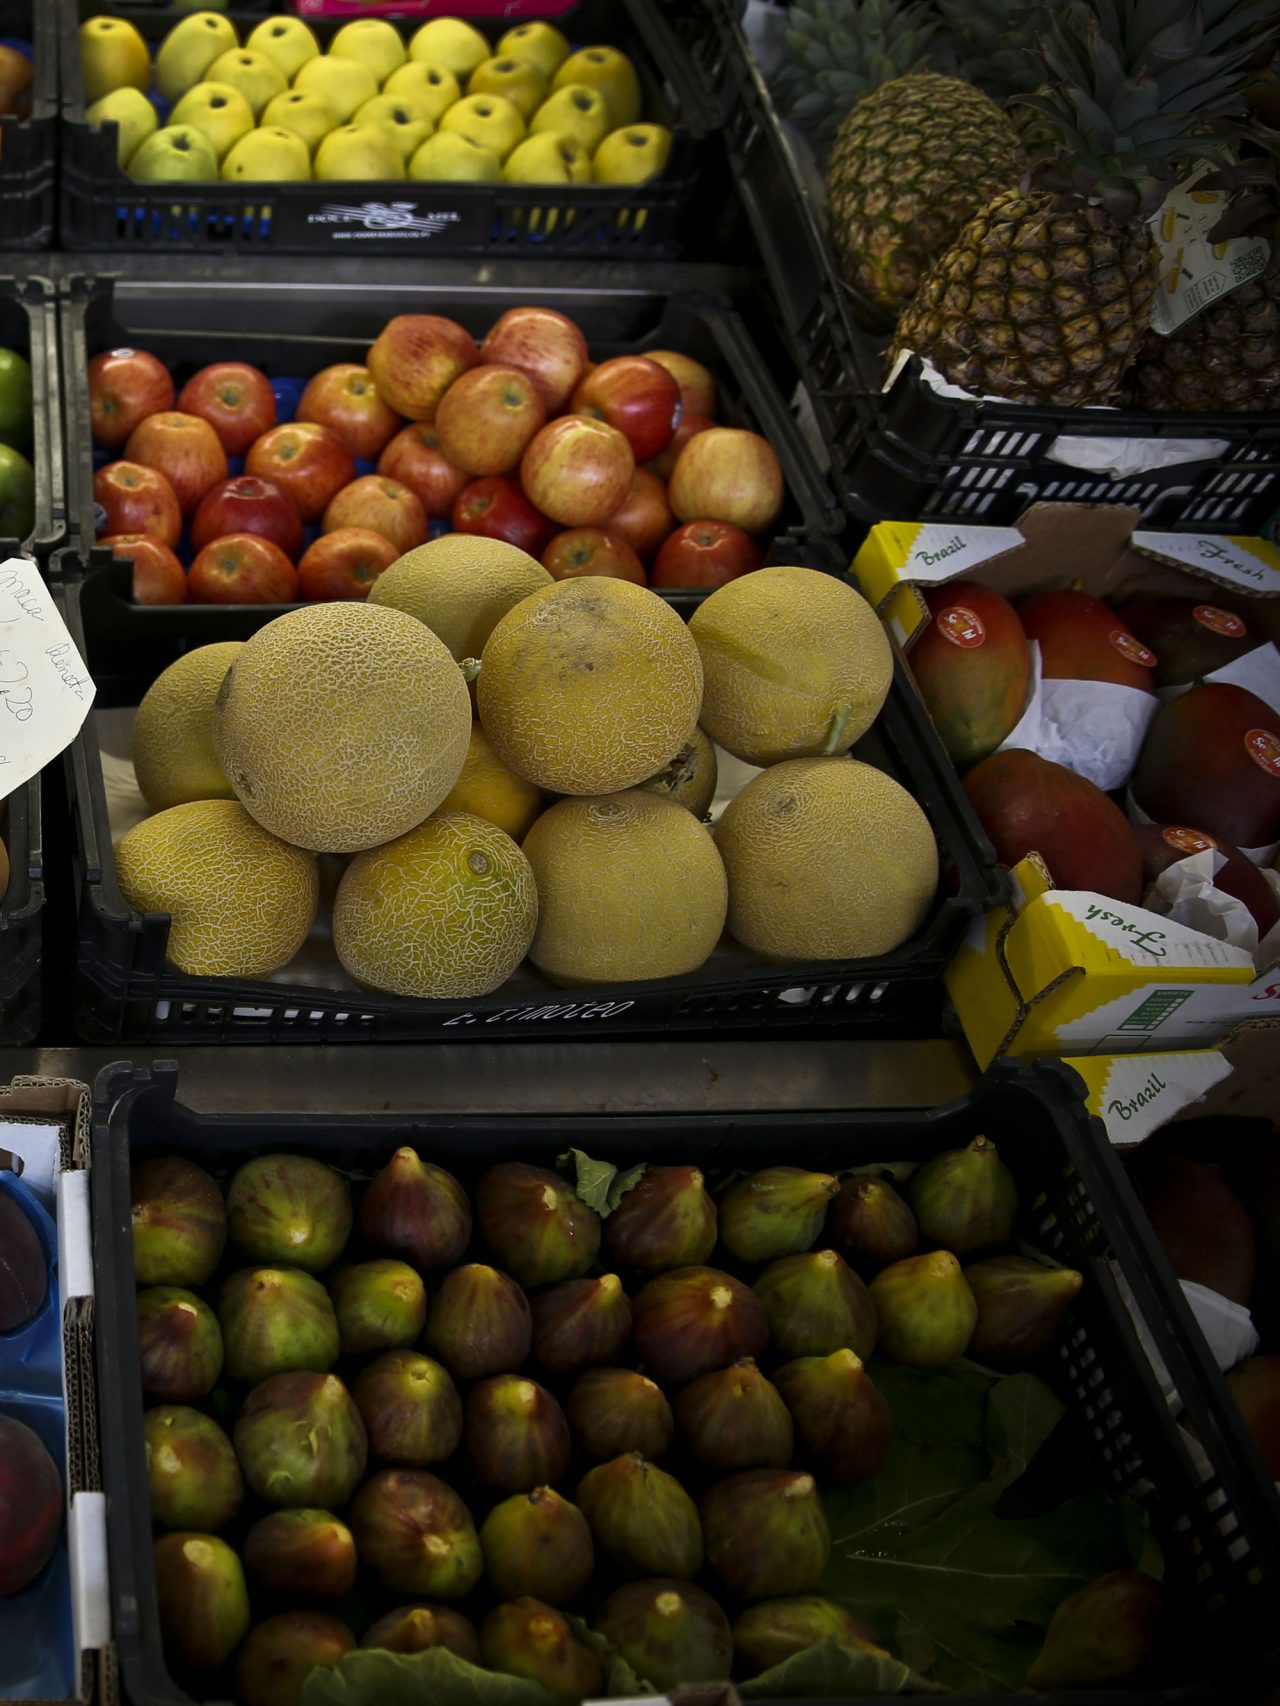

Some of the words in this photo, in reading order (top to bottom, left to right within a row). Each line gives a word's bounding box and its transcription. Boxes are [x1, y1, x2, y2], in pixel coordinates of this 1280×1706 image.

[914, 535, 968, 566] Brazil
[1198, 540, 1265, 580] Fresh
[1085, 904, 1167, 957] Fresh
[1107, 1072, 1167, 1121] Brazil
